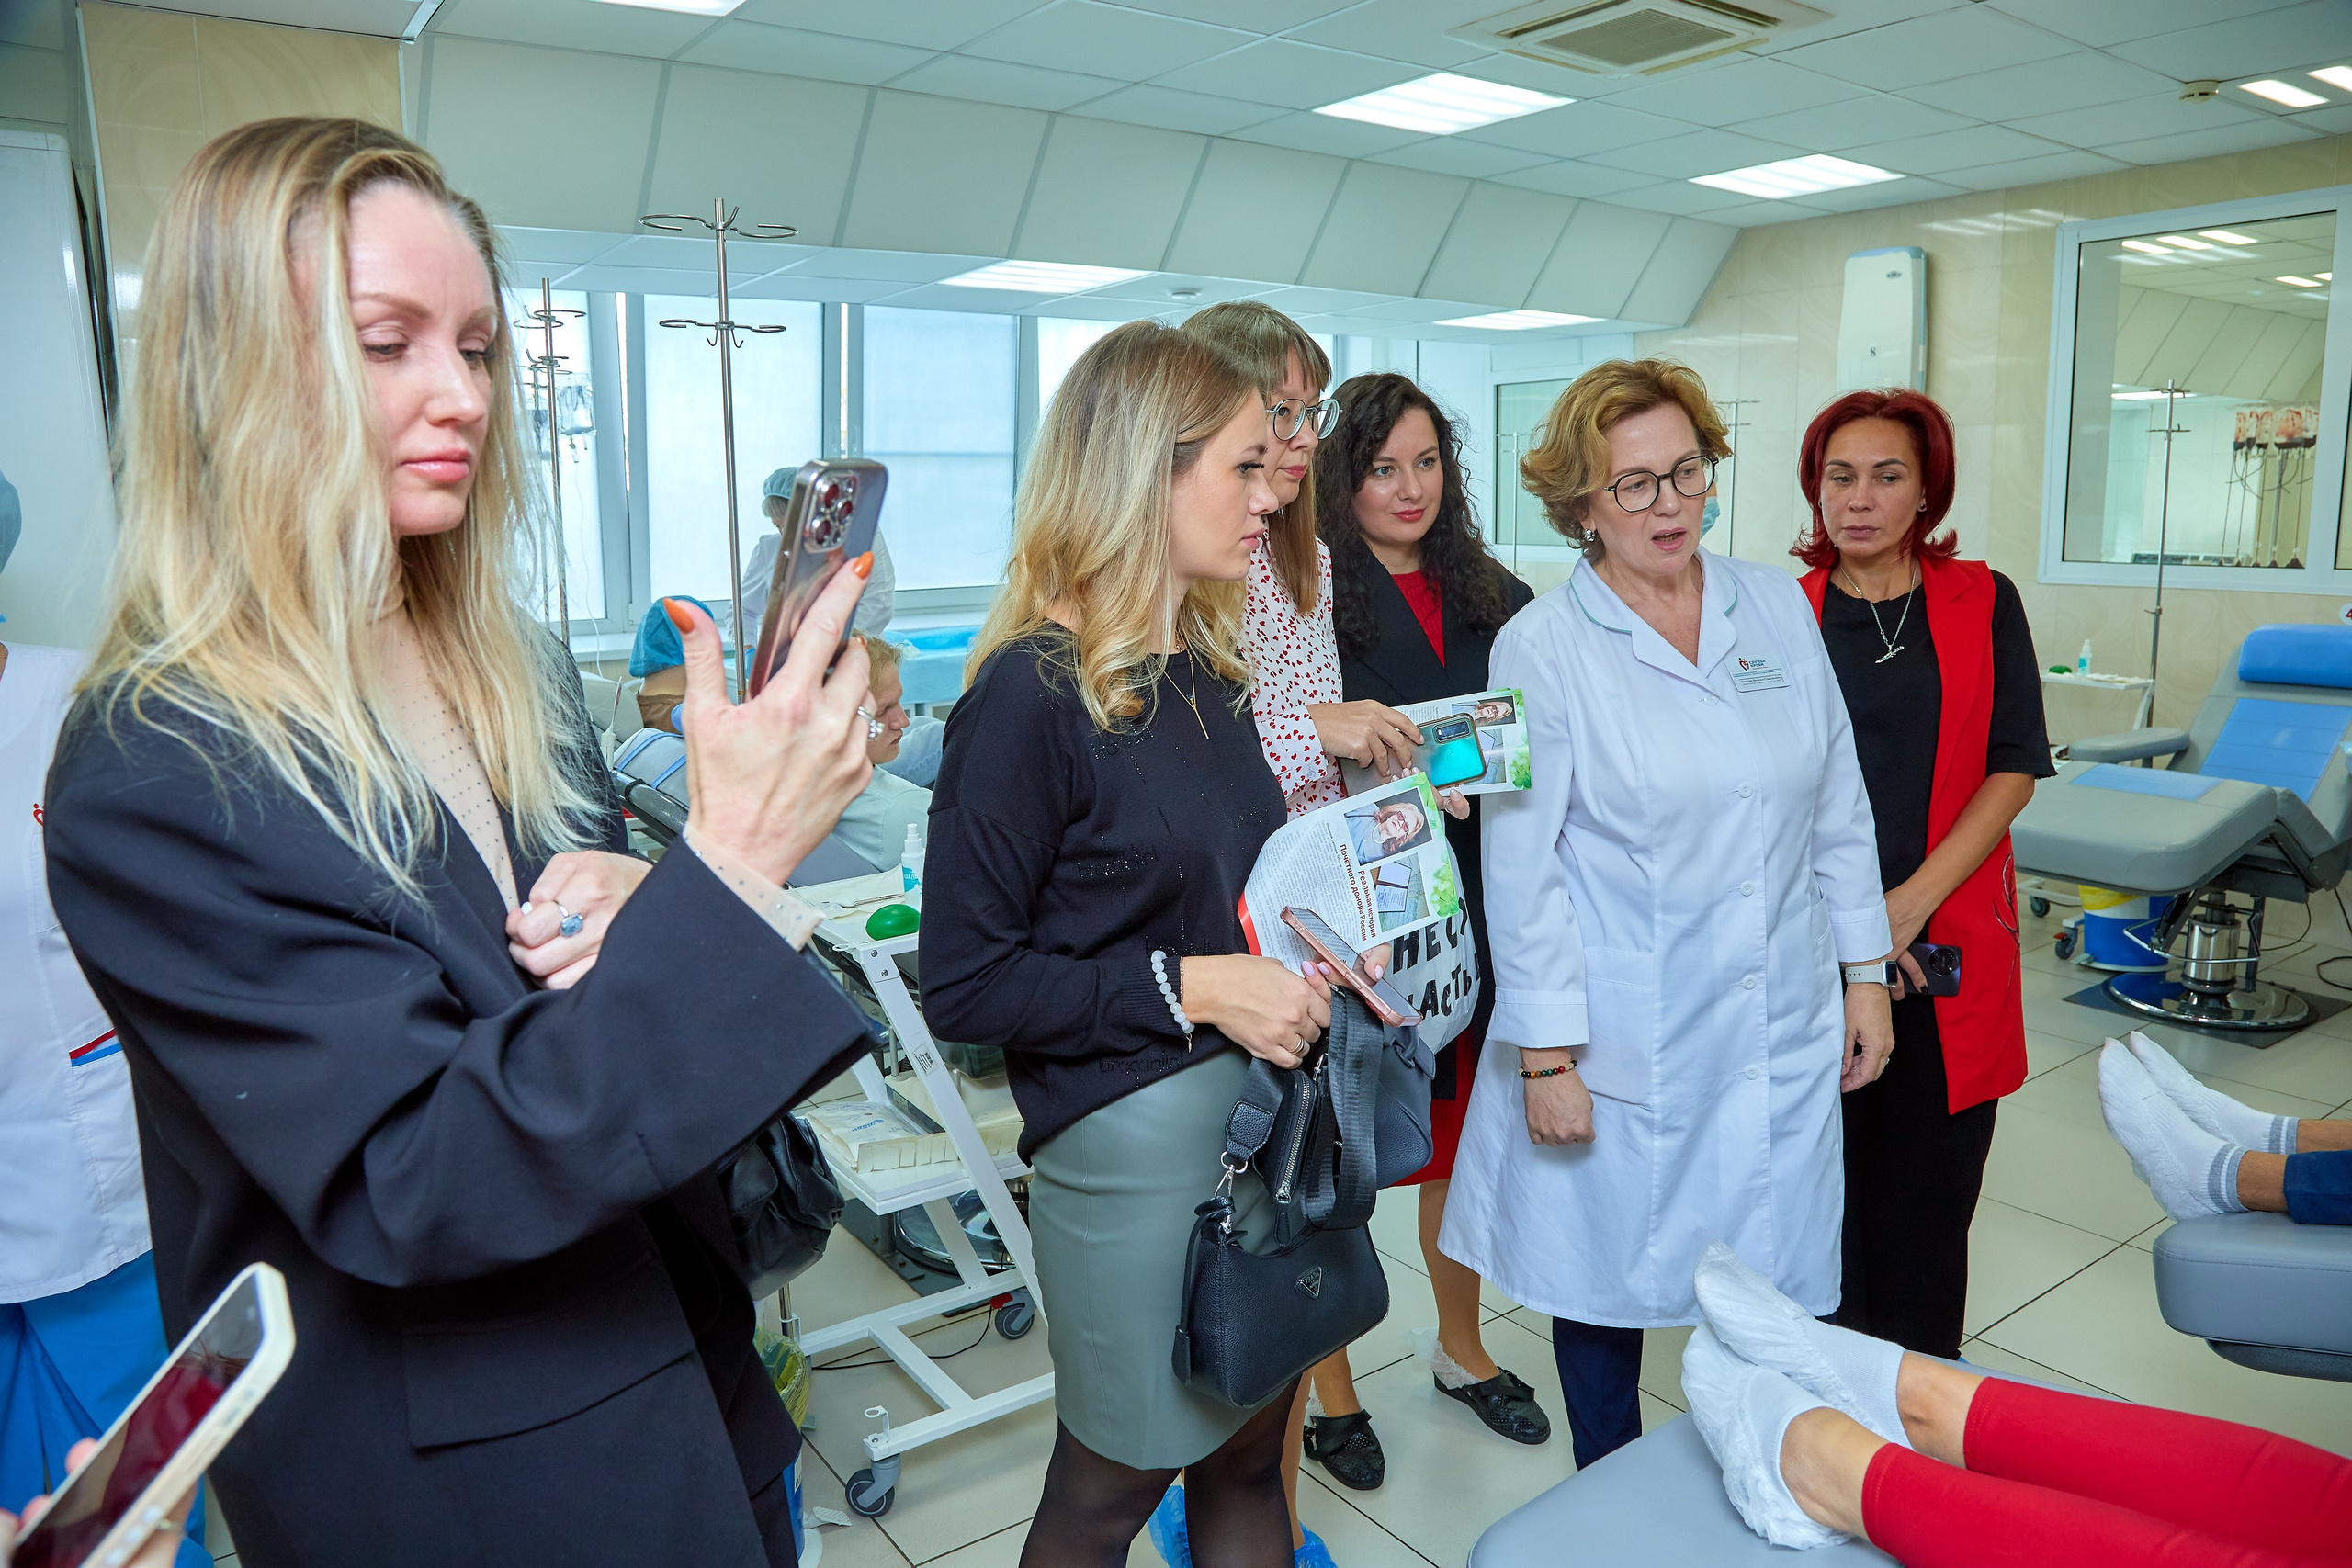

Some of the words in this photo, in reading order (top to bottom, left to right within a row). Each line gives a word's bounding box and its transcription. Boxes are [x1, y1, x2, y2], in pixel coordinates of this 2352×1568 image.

[1340, 844, 1356, 886] Почётного
[1351, 886, 1363, 915] донора
[1359, 915, 1367, 942] России
[1358, 870, 1371, 908] Реальная
[1368, 908, 1376, 938] история
